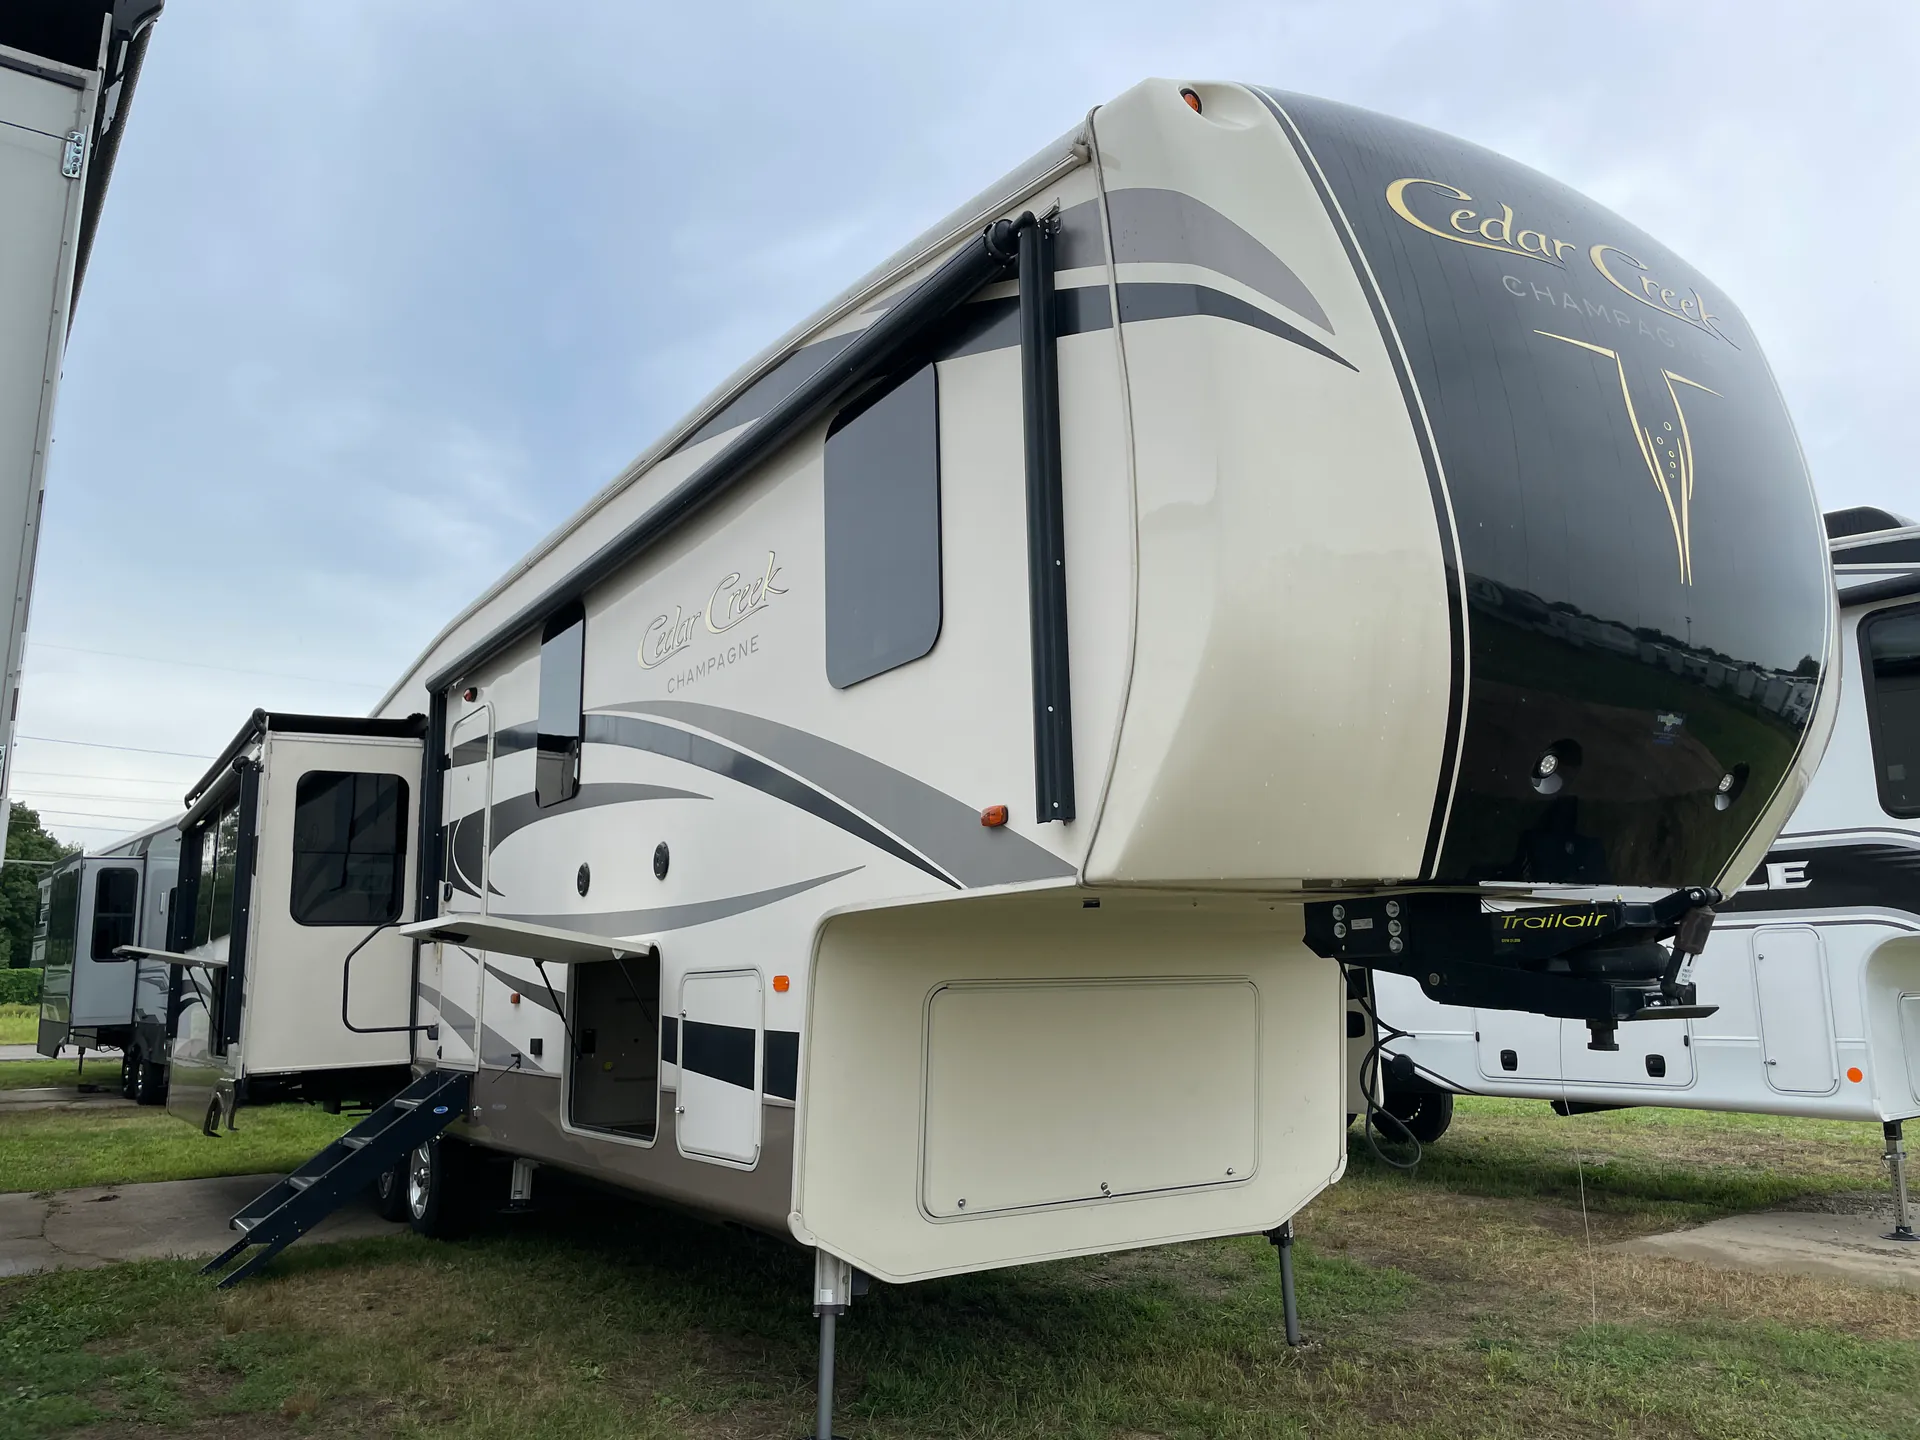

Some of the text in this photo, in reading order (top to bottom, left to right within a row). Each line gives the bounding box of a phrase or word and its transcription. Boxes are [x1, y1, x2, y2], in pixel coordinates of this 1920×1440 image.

[1385, 177, 1742, 351] Cedar Creek
[1502, 274, 1714, 365] CHAMPAG
[637, 550, 789, 670] Cedar Creek
[667, 634, 760, 694] CHAMPAGNE
[1501, 912, 1608, 929] Trailair
